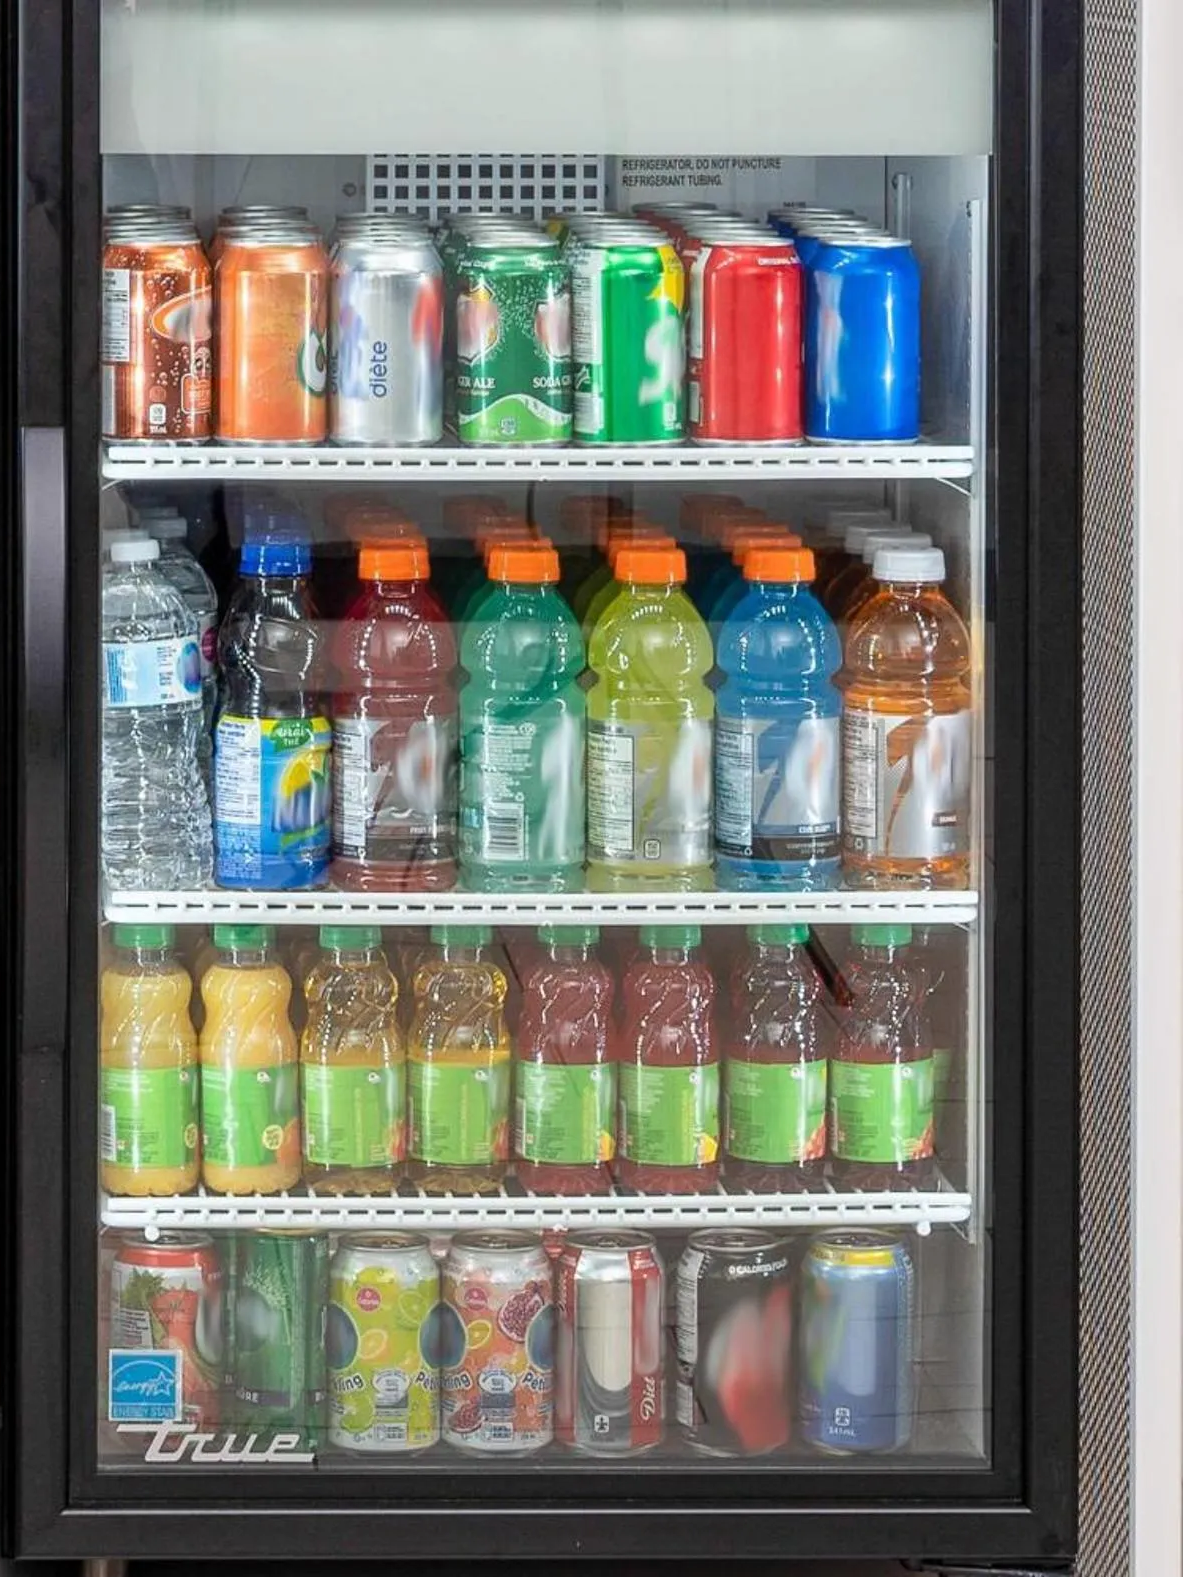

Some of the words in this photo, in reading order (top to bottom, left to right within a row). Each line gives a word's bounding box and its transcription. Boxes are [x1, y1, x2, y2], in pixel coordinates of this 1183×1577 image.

[696, 158, 709, 169] DO
[711, 158, 730, 169] NOT
[731, 157, 782, 169] PUNCTURE
[621, 175, 685, 187] REFRIGERANT
[473, 377, 496, 389] ALE
[533, 377, 561, 388] SODA
[639, 1376, 656, 1421] Diet
[113, 1405, 150, 1417] ENERGY
[152, 1405, 174, 1417] STAR
